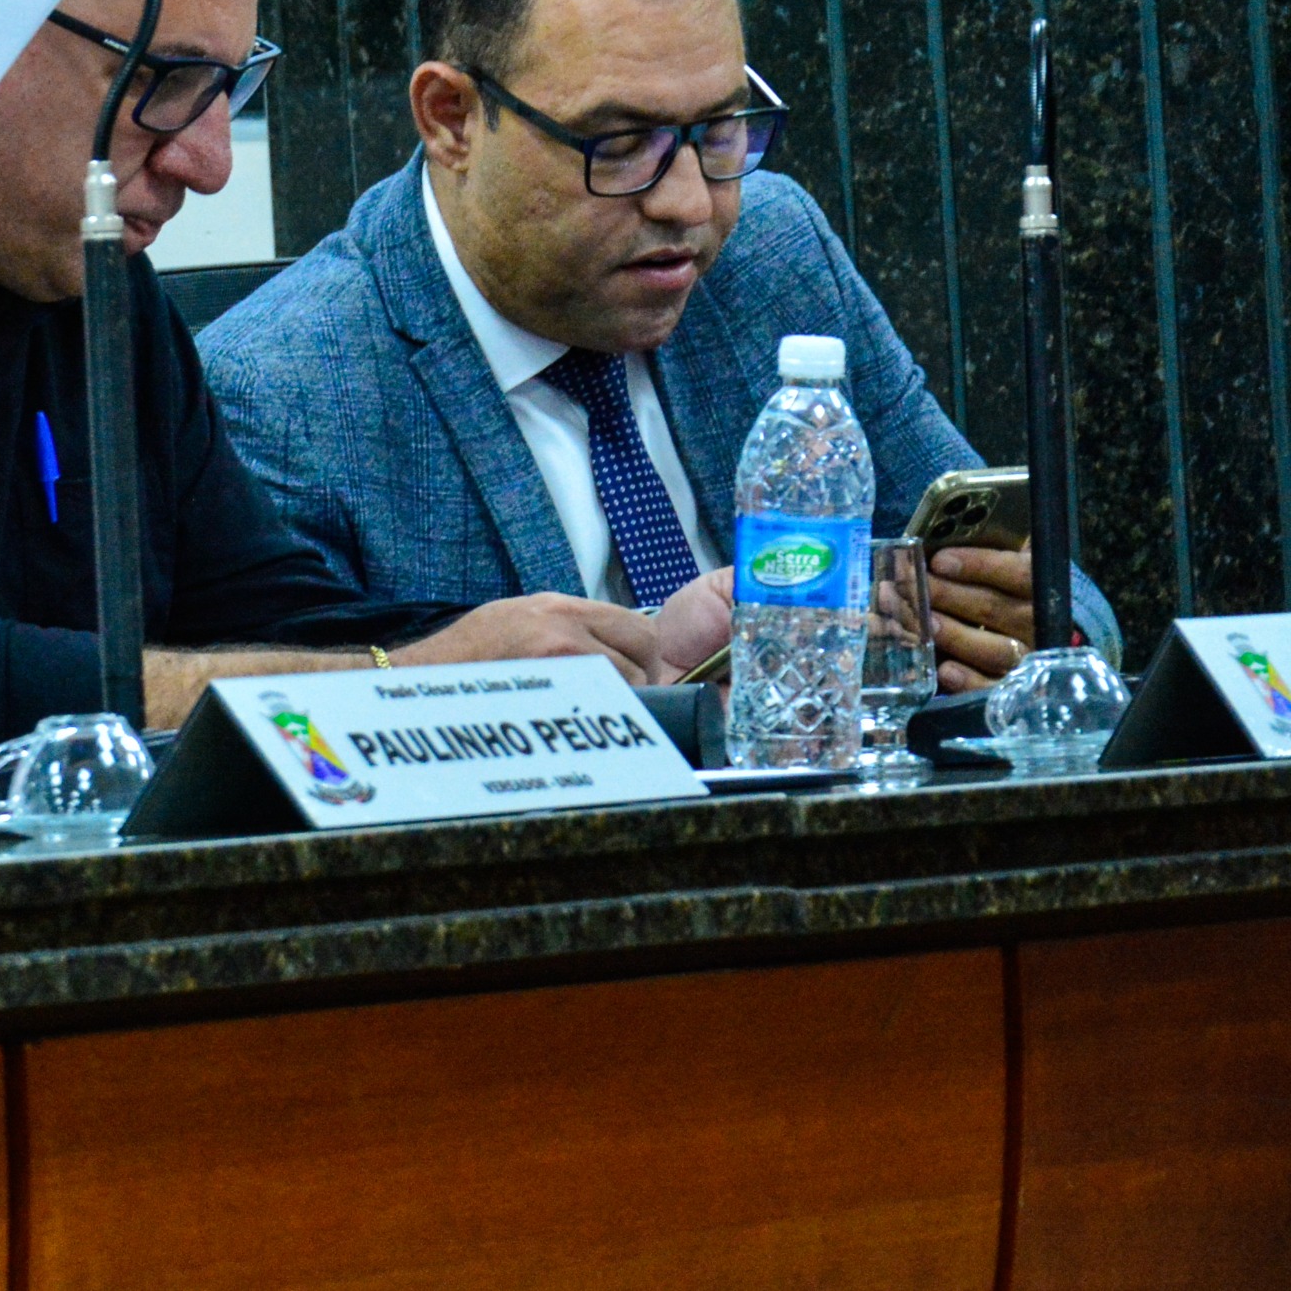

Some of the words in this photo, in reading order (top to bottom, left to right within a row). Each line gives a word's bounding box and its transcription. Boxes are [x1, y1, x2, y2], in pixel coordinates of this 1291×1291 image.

[763, 559, 814, 577] Negra
[776, 550, 819, 566] Serra
[374, 684, 417, 699] Paulo
[475, 677, 512, 692] Lima
[348, 721, 534, 767] PAULINHO
[529, 706, 657, 753] PEÚCA
